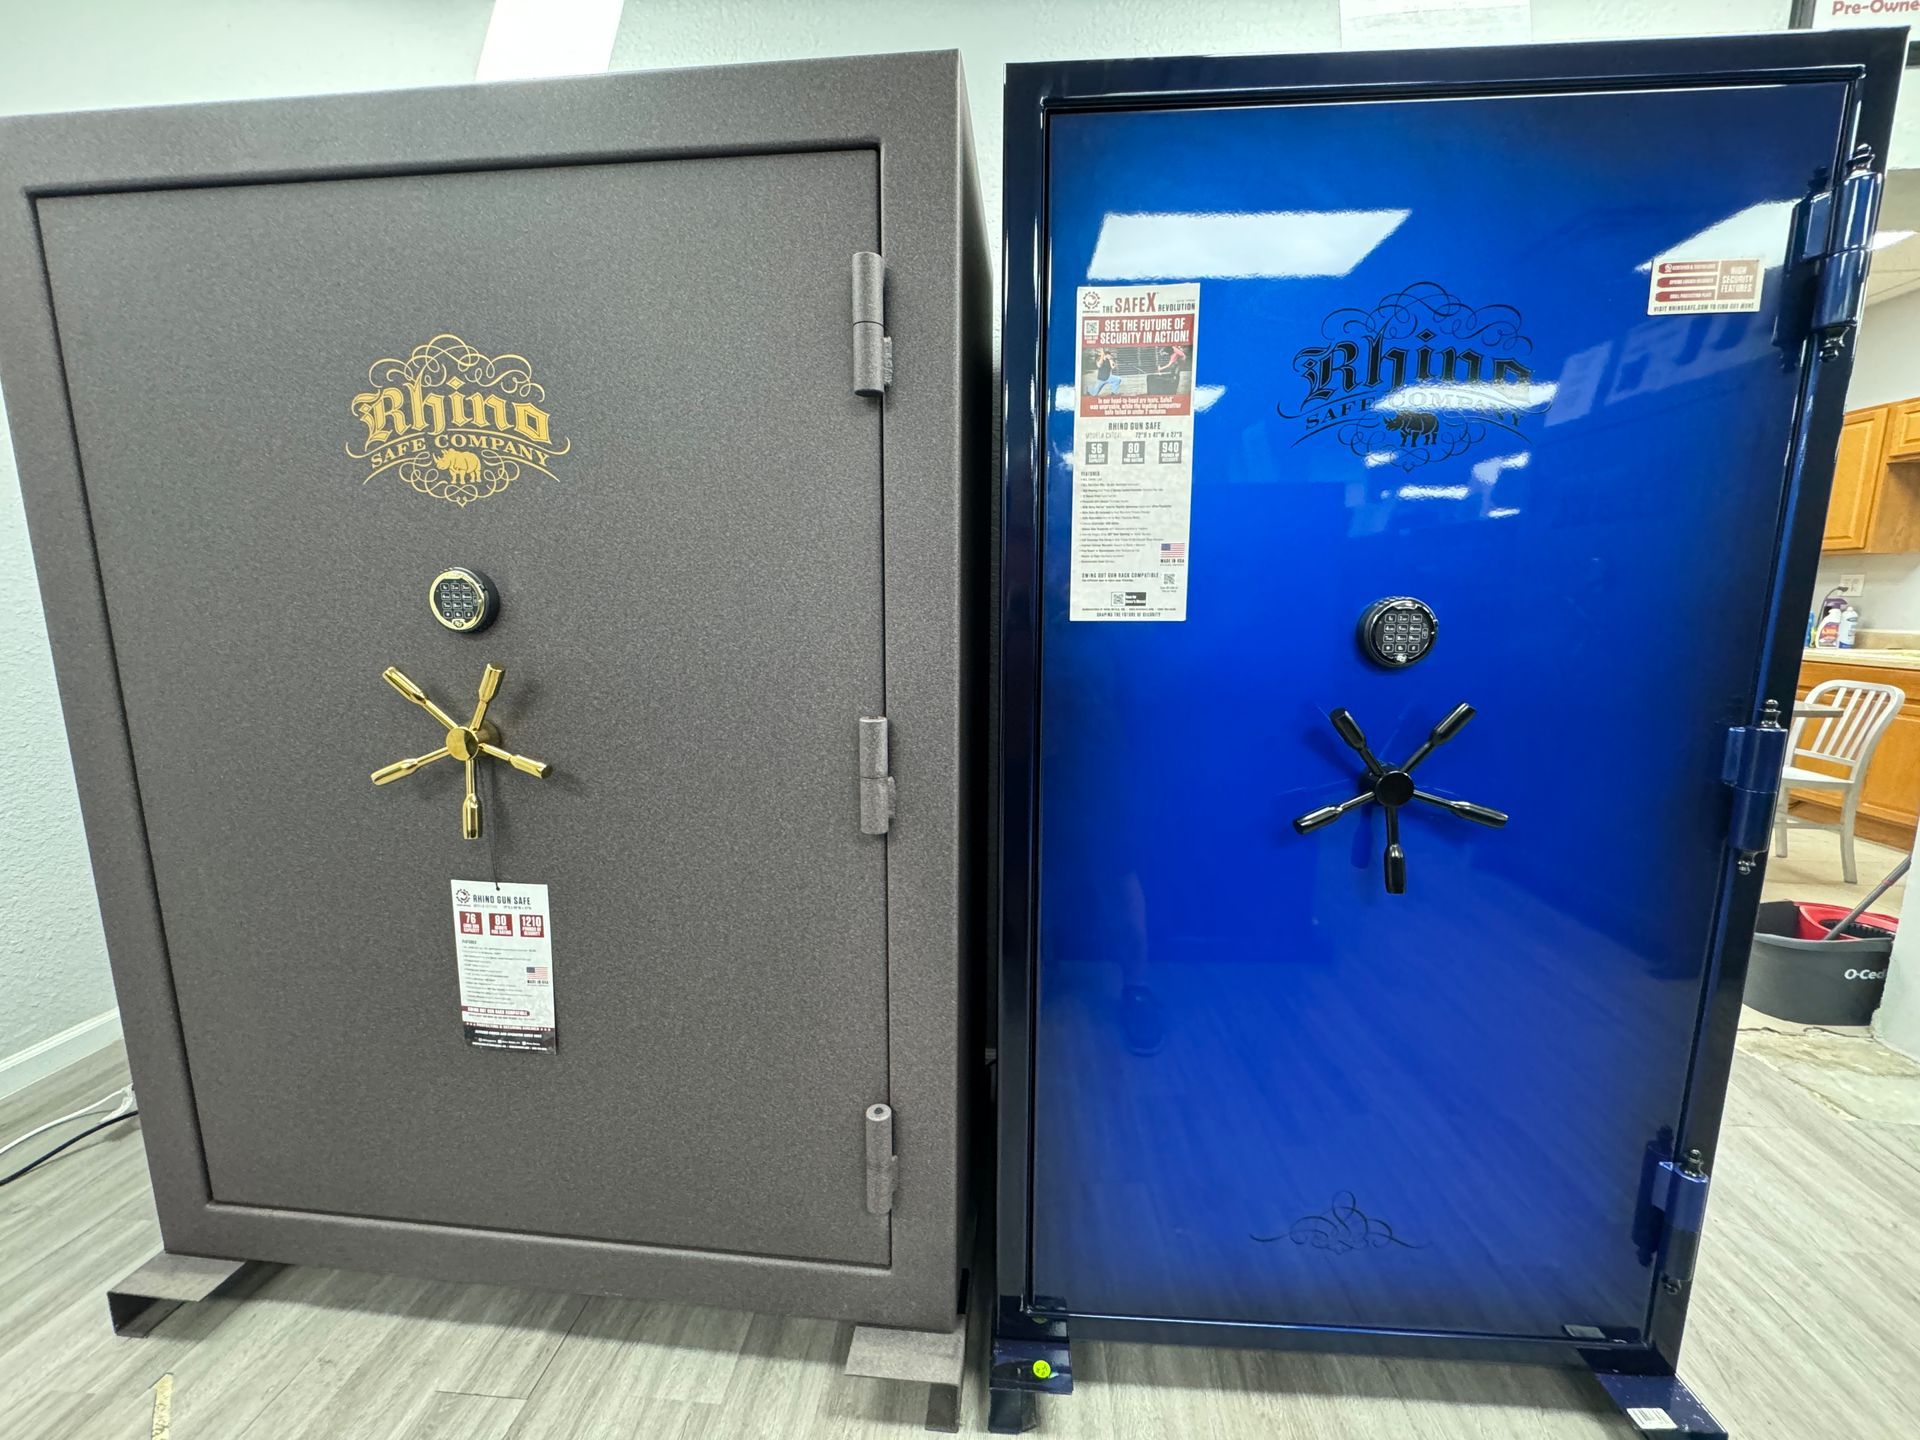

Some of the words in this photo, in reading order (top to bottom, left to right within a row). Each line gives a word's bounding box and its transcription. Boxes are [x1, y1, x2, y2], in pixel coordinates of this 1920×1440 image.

[1832, 0, 1920, 15] Pre-Owne
[1102, 305, 1113, 313] THE
[1157, 303, 1195, 312] REVOLUTION
[1104, 320, 1121, 331] SEE
[1122, 319, 1138, 331] THE
[1139, 318, 1173, 330] FUTURE
[1174, 317, 1185, 329] OF
[1100, 331, 1141, 344] SECURITY
[1143, 331, 1152, 343] IN
[1154, 330, 1189, 343] ACTION!
[352, 372, 552, 450] Rhino
[1304, 397, 1377, 430] SAFE
[1108, 422, 1129, 431] RHINO
[1130, 422, 1144, 430] GUN
[1145, 421, 1161, 430] SAFE
[370, 437, 427, 468] SAFE
[435, 433, 550, 467] COMPANY
[1090, 443, 1103, 454] 56
[1128, 442, 1139, 453] 80
[1162, 442, 1179, 453] 940
[473, 894, 495, 904] RHINO
[497, 896, 511, 905] GUN
[513, 897, 531, 905] SAFE
[465, 913, 477, 924] 76
[494, 915, 507, 926] 80
[521, 916, 542, 927] 1210
[1844, 968, 1888, 980] O-Ced
